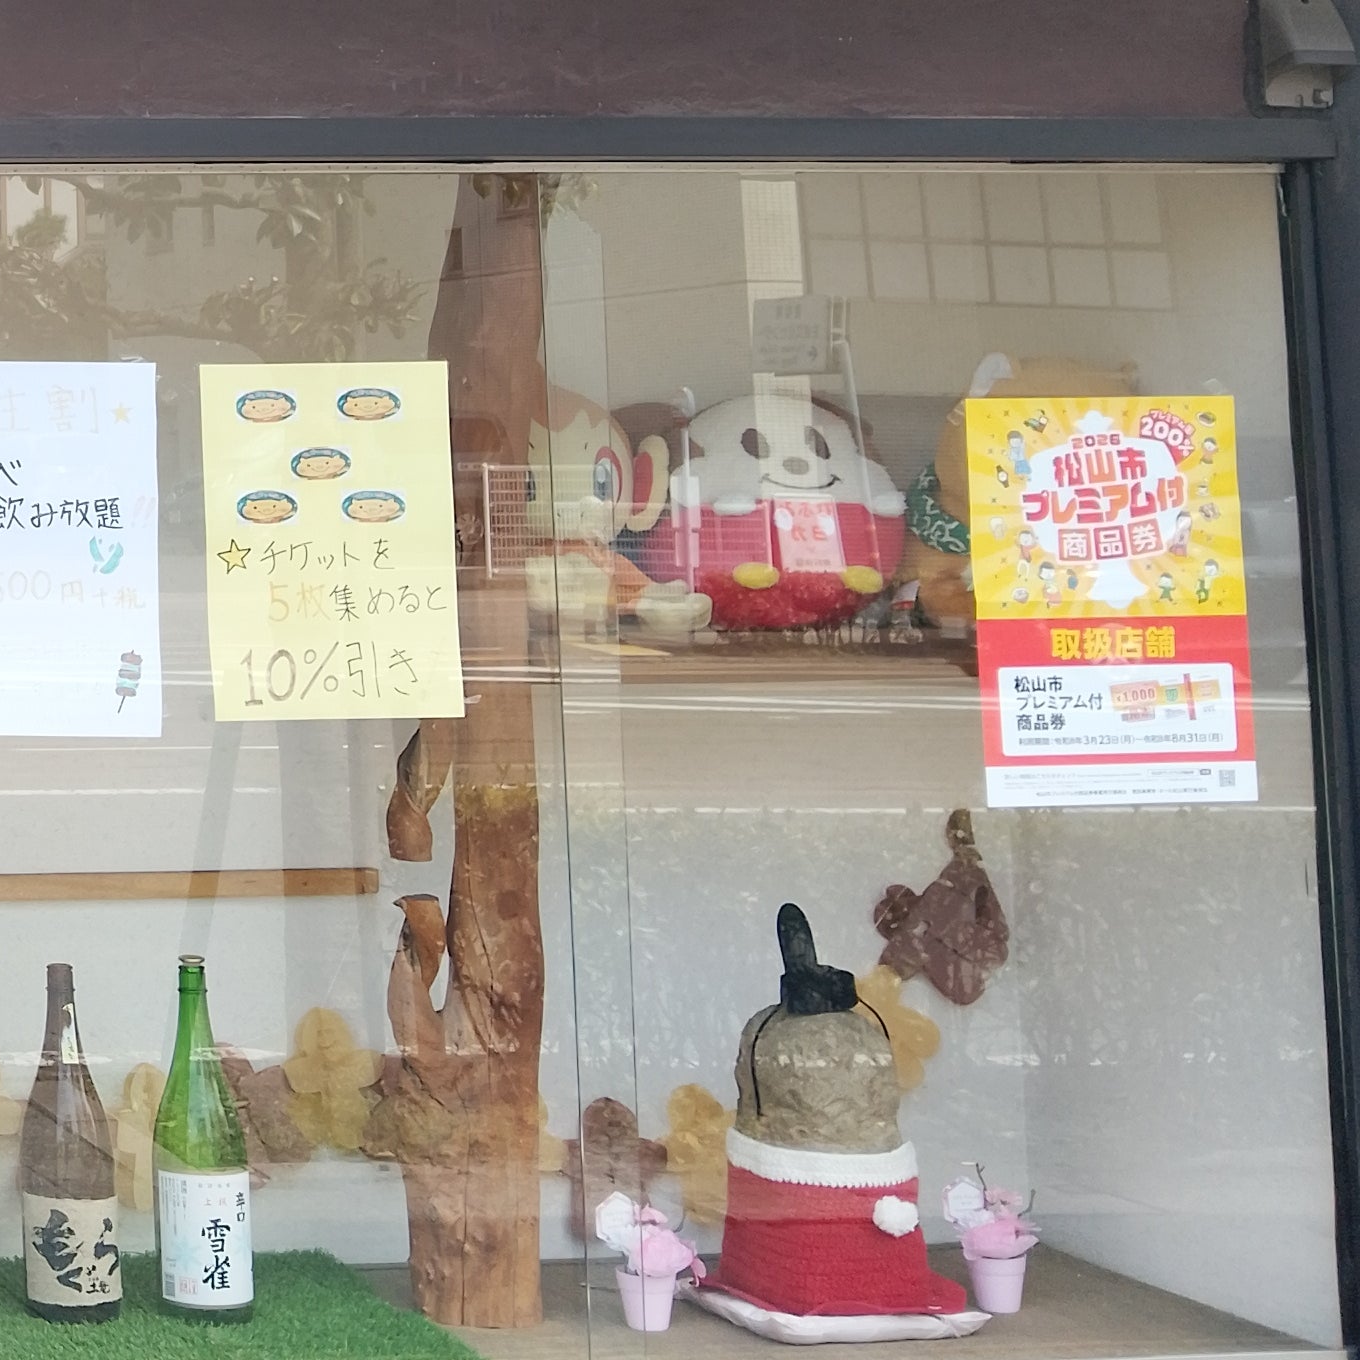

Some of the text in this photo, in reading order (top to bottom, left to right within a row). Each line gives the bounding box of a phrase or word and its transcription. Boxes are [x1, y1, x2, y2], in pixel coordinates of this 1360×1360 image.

[1141, 416, 1194, 457] 200%
[1052, 446, 1147, 488] 松山市
[1022, 474, 1186, 525] プレミアム付
[261, 537, 395, 575] チケットを
[1061, 520, 1162, 560] 商品券
[268, 580, 448, 624] 5枚集めると
[1050, 626, 1176, 660] 取扱店舗
[240, 641, 420, 708] 10%引き
[1014, 675, 1063, 693] 松山市
[1016, 692, 1104, 711] プレミアム付
[1016, 713, 1067, 731] 商品券
[235, 1191, 245, 1222] 辛口
[201, 1218, 231, 1290] 雪雀
